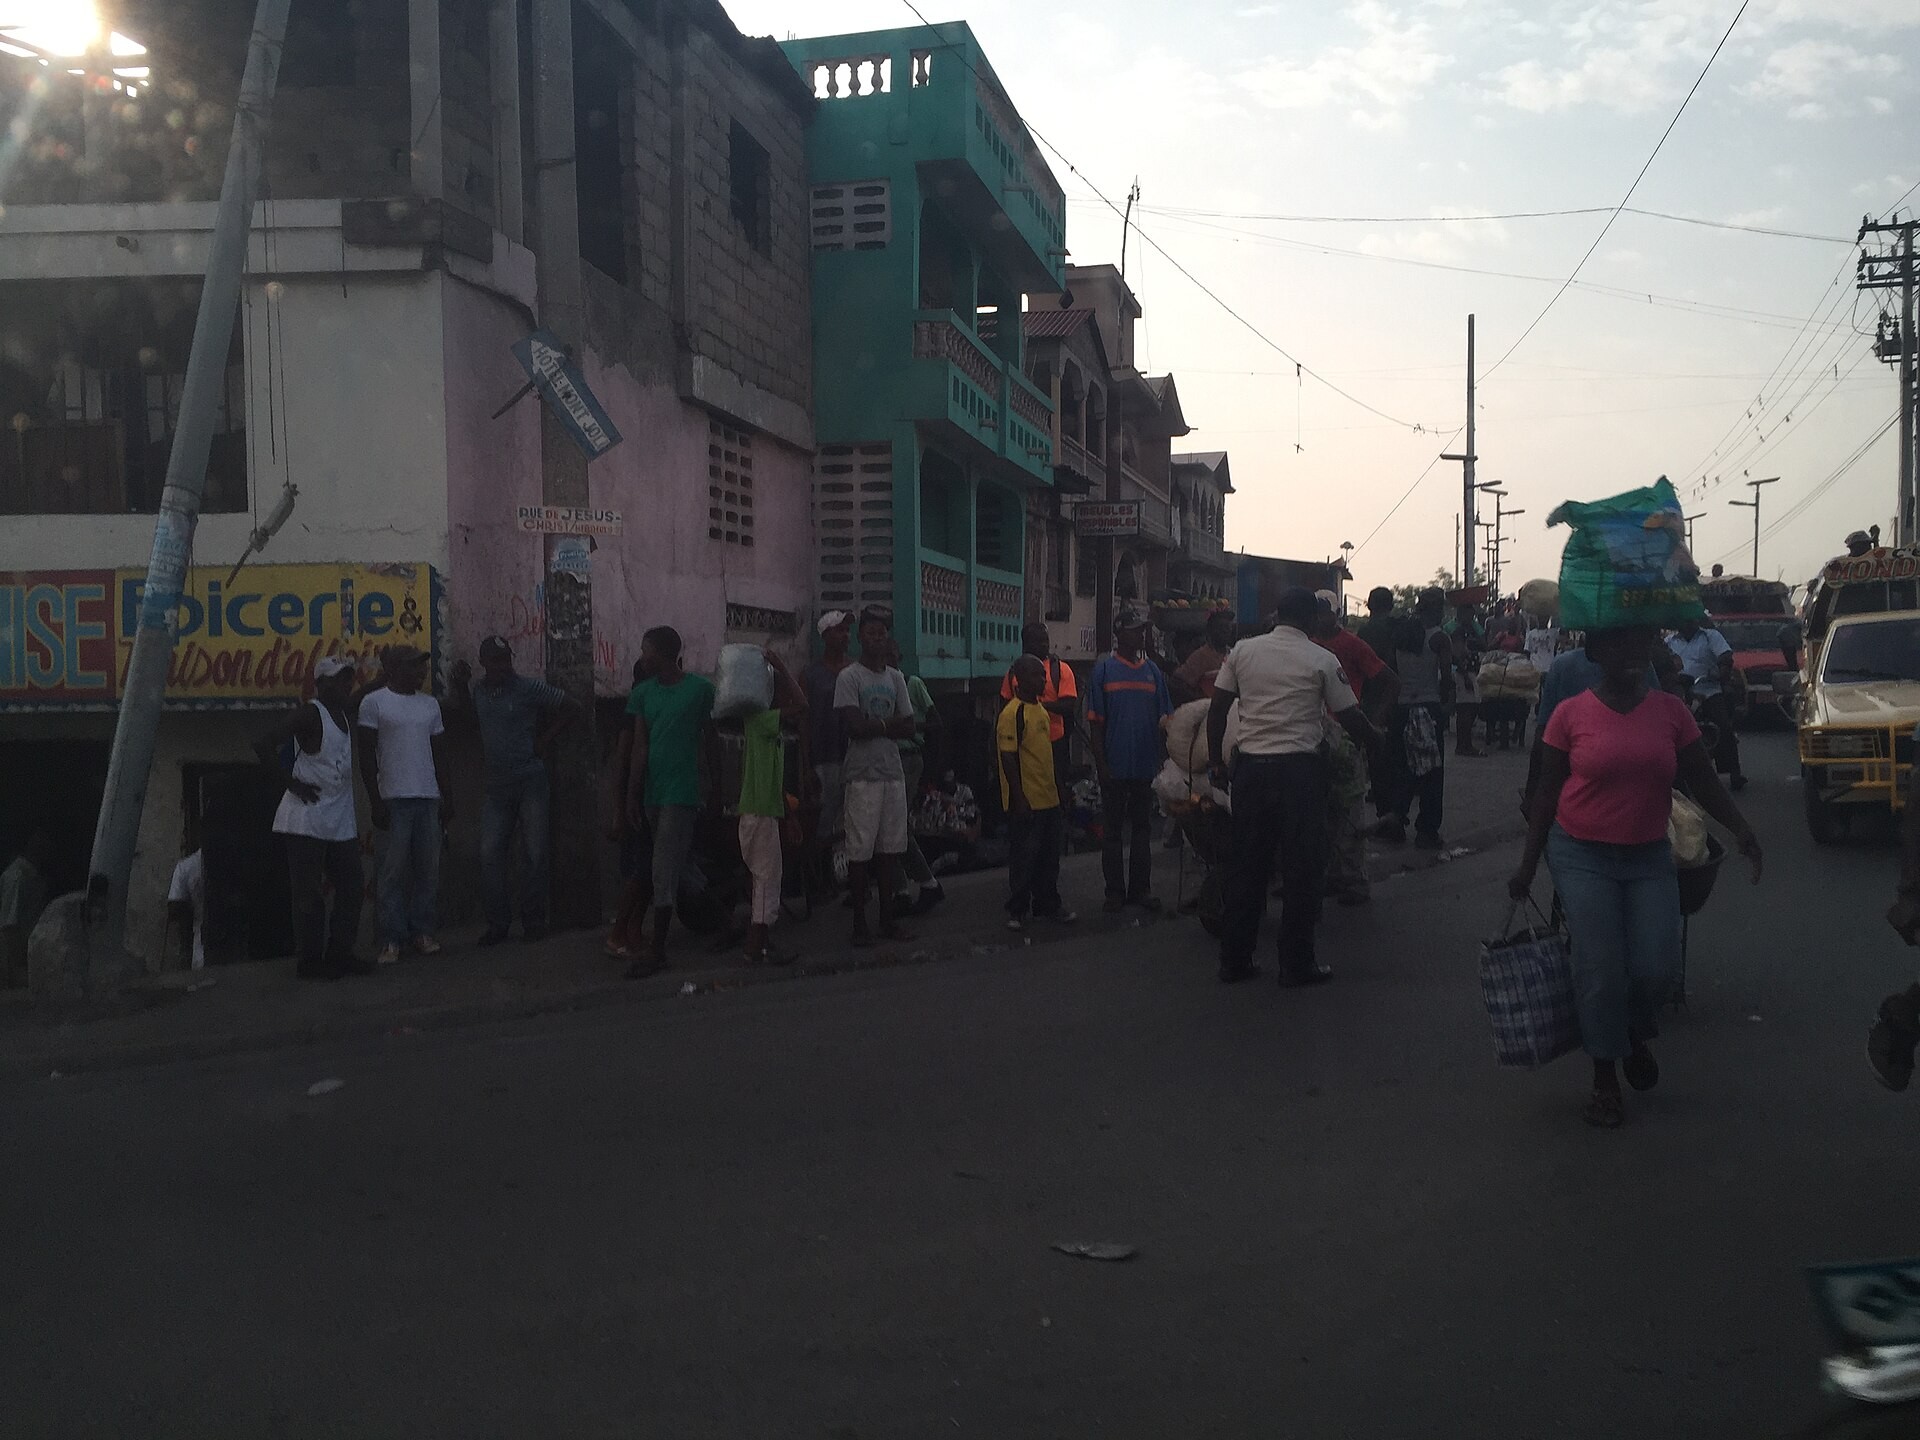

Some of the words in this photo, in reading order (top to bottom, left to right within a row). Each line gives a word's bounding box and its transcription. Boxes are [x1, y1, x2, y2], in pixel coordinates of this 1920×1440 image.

[557, 384, 590, 419] MONT
[519, 507, 543, 518] RUE
[545, 509, 559, 520] DE
[1829, 558, 1920, 581] MOND
[399, 590, 424, 633] &
